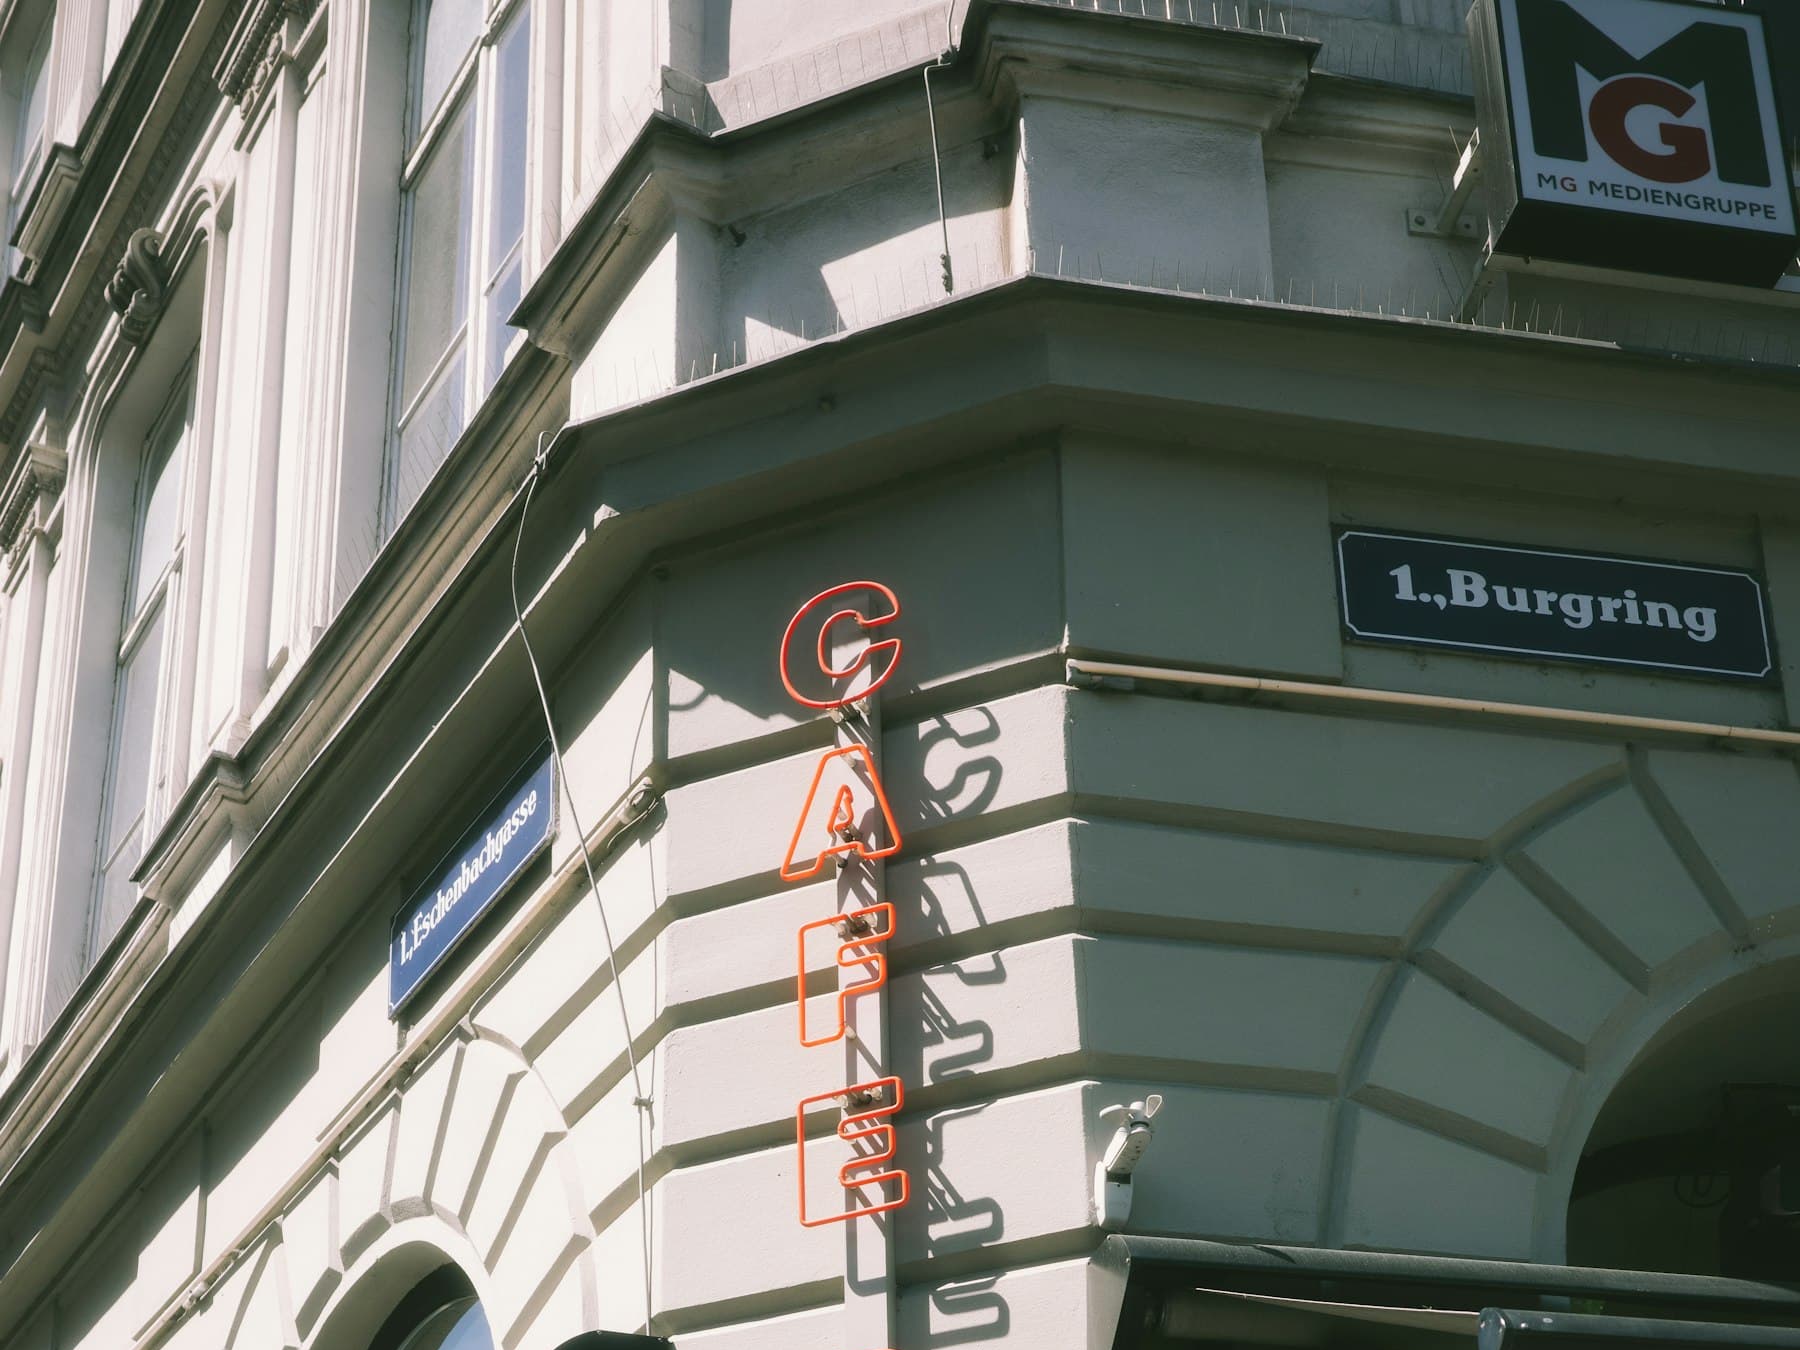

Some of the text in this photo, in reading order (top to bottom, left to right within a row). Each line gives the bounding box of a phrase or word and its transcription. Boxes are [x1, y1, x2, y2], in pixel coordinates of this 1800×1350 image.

[1537, 172, 1777, 220] MG MEDIENGRUPPE
[780, 580, 910, 1228] CAFE
